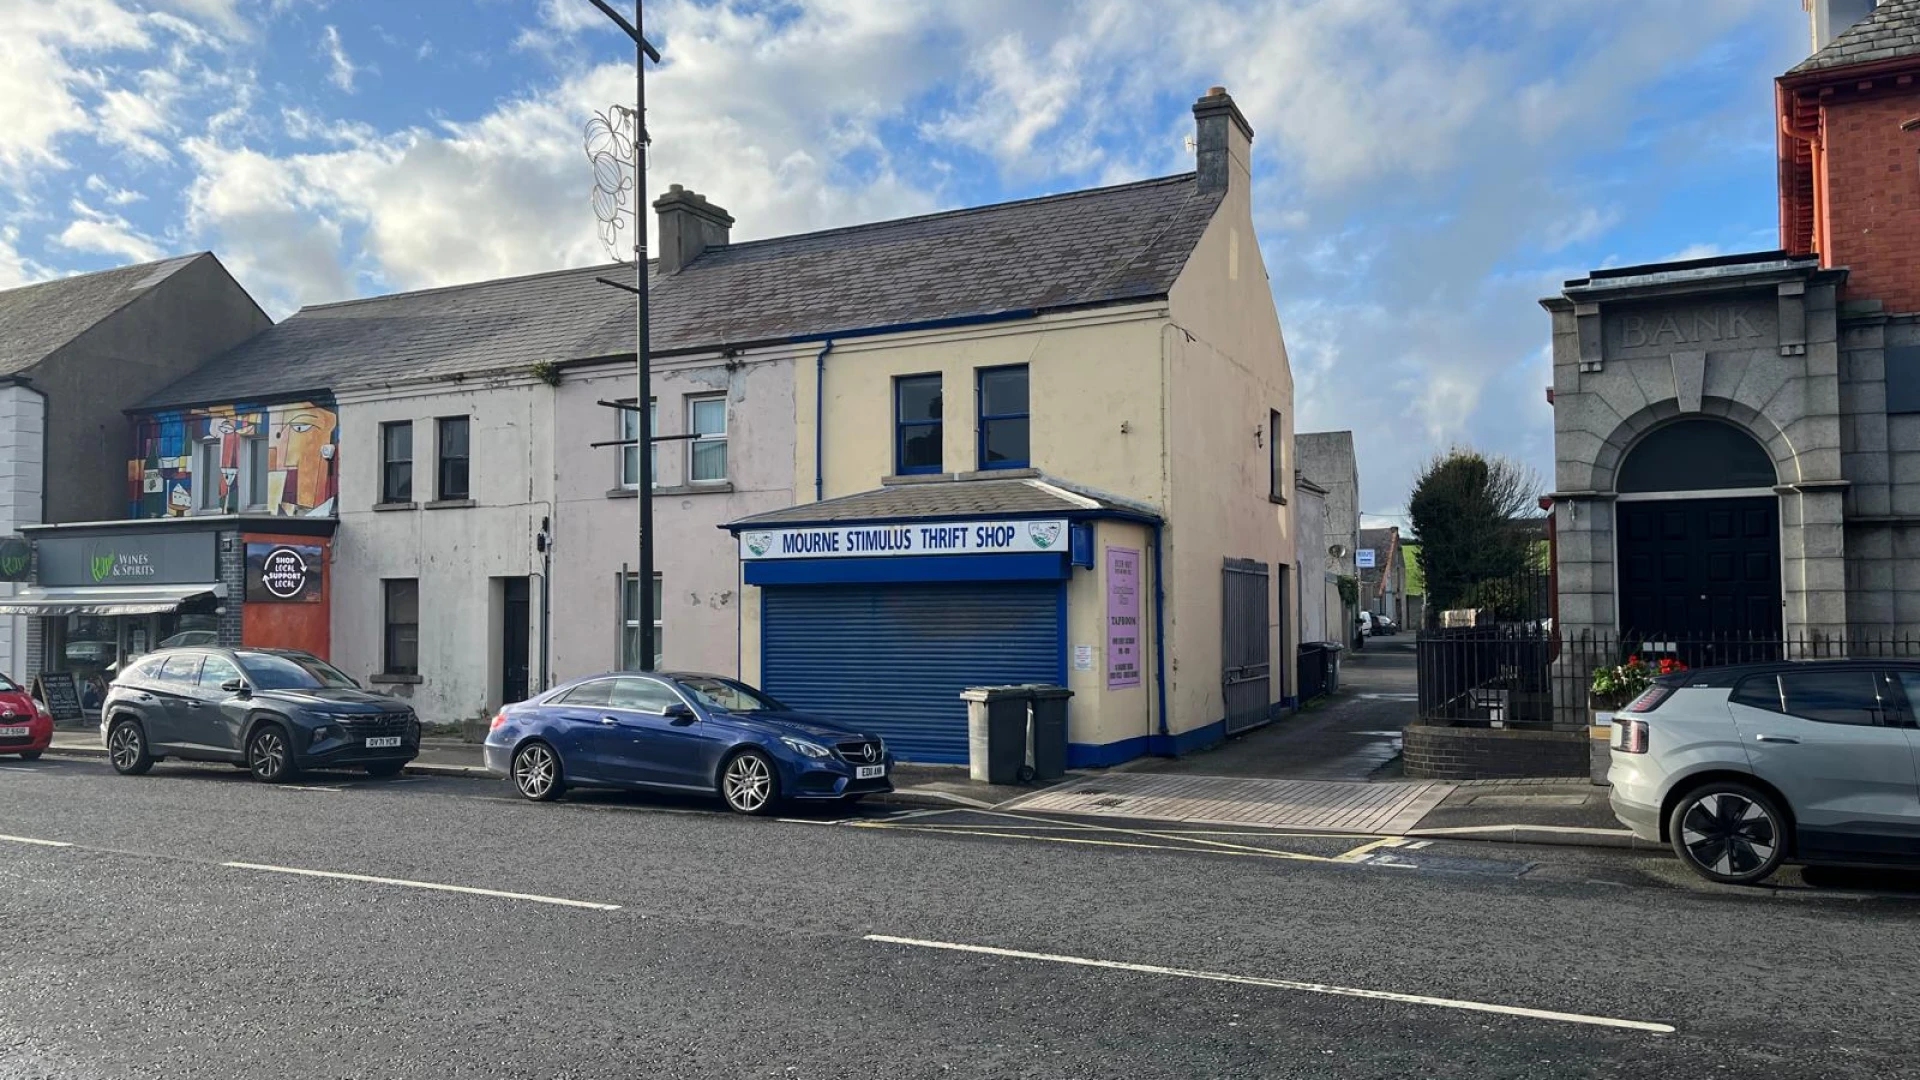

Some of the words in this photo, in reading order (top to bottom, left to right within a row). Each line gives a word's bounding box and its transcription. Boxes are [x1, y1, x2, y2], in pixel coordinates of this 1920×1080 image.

[1621, 305, 1763, 348] BANK
[783, 532, 839, 553] MOURNE
[847, 528, 911, 552] STIMULUS
[921, 527, 968, 549] THRIFT
[976, 526, 1015, 548] SHOP
[119, 553, 148, 565] WINES
[113, 564, 120, 576] &
[122, 565, 154, 576] SPIRITS
[275, 564, 295, 572] LOCAL
[269, 572, 301, 580] SUPPORT
[275, 580, 295, 588] LOCAL
